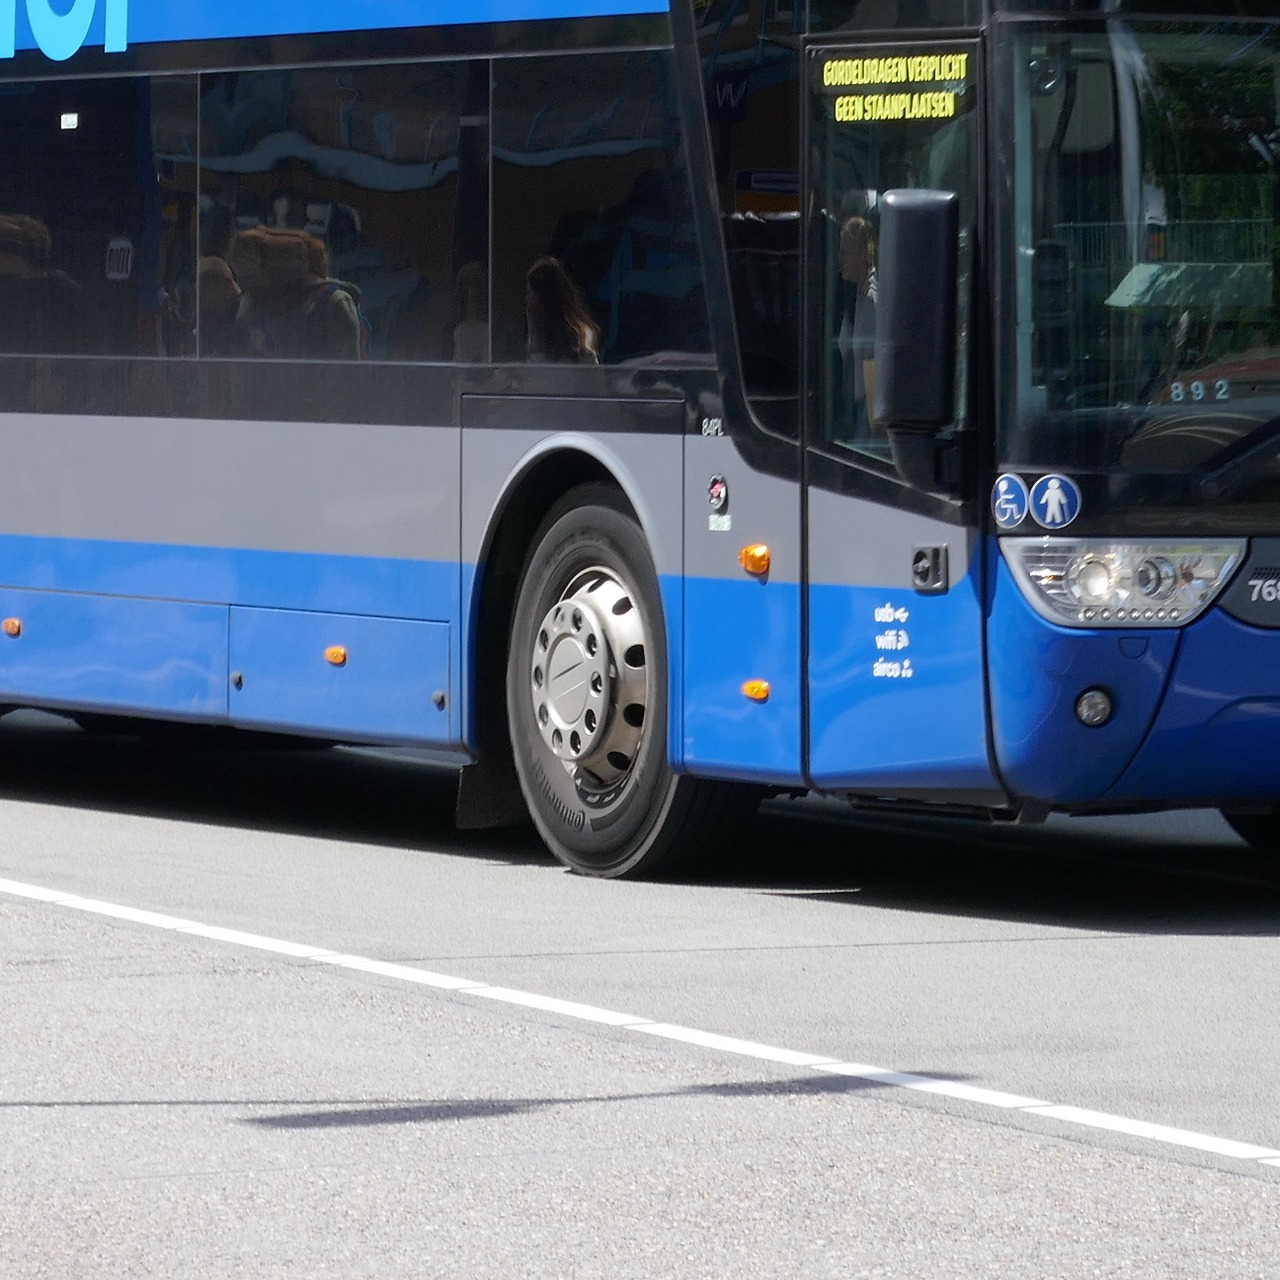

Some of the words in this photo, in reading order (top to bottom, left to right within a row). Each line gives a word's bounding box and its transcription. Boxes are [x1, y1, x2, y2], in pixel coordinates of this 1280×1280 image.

[907, 53, 969, 82] VERPLICHT
[835, 95, 864, 122] GEEN
[864, 90, 955, 120] STAANPLAATSEN
[874, 602, 895, 623] usb
[875, 629, 897, 651] wifi
[873, 656, 901, 677] airco
